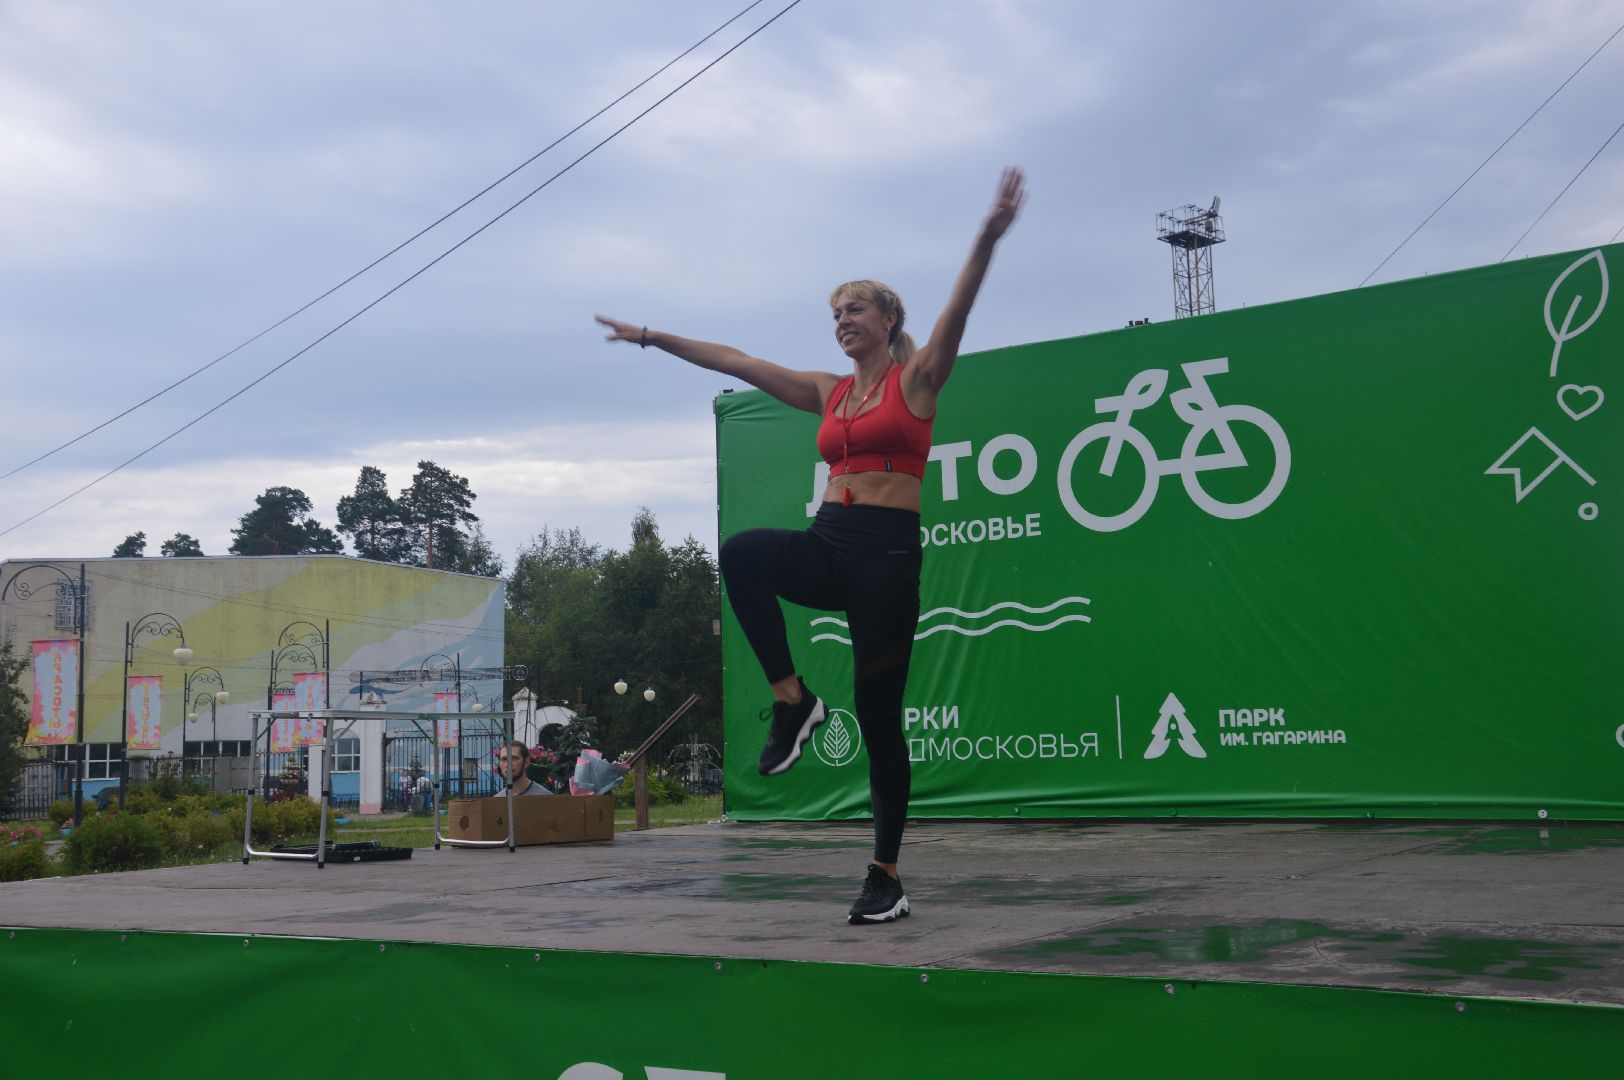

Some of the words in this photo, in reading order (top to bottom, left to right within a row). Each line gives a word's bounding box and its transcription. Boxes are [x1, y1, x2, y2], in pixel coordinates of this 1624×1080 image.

[806, 433, 1038, 518] ТО
[920, 512, 1042, 548] ОСКОВЬЕ
[904, 705, 959, 731] РКИ
[1218, 707, 1286, 728] ПАРК
[908, 732, 1099, 762] ДМОСКОВЬЯ
[1220, 732, 1249, 746] ИМ.
[1253, 729, 1347, 746] ГАГАРИНА
